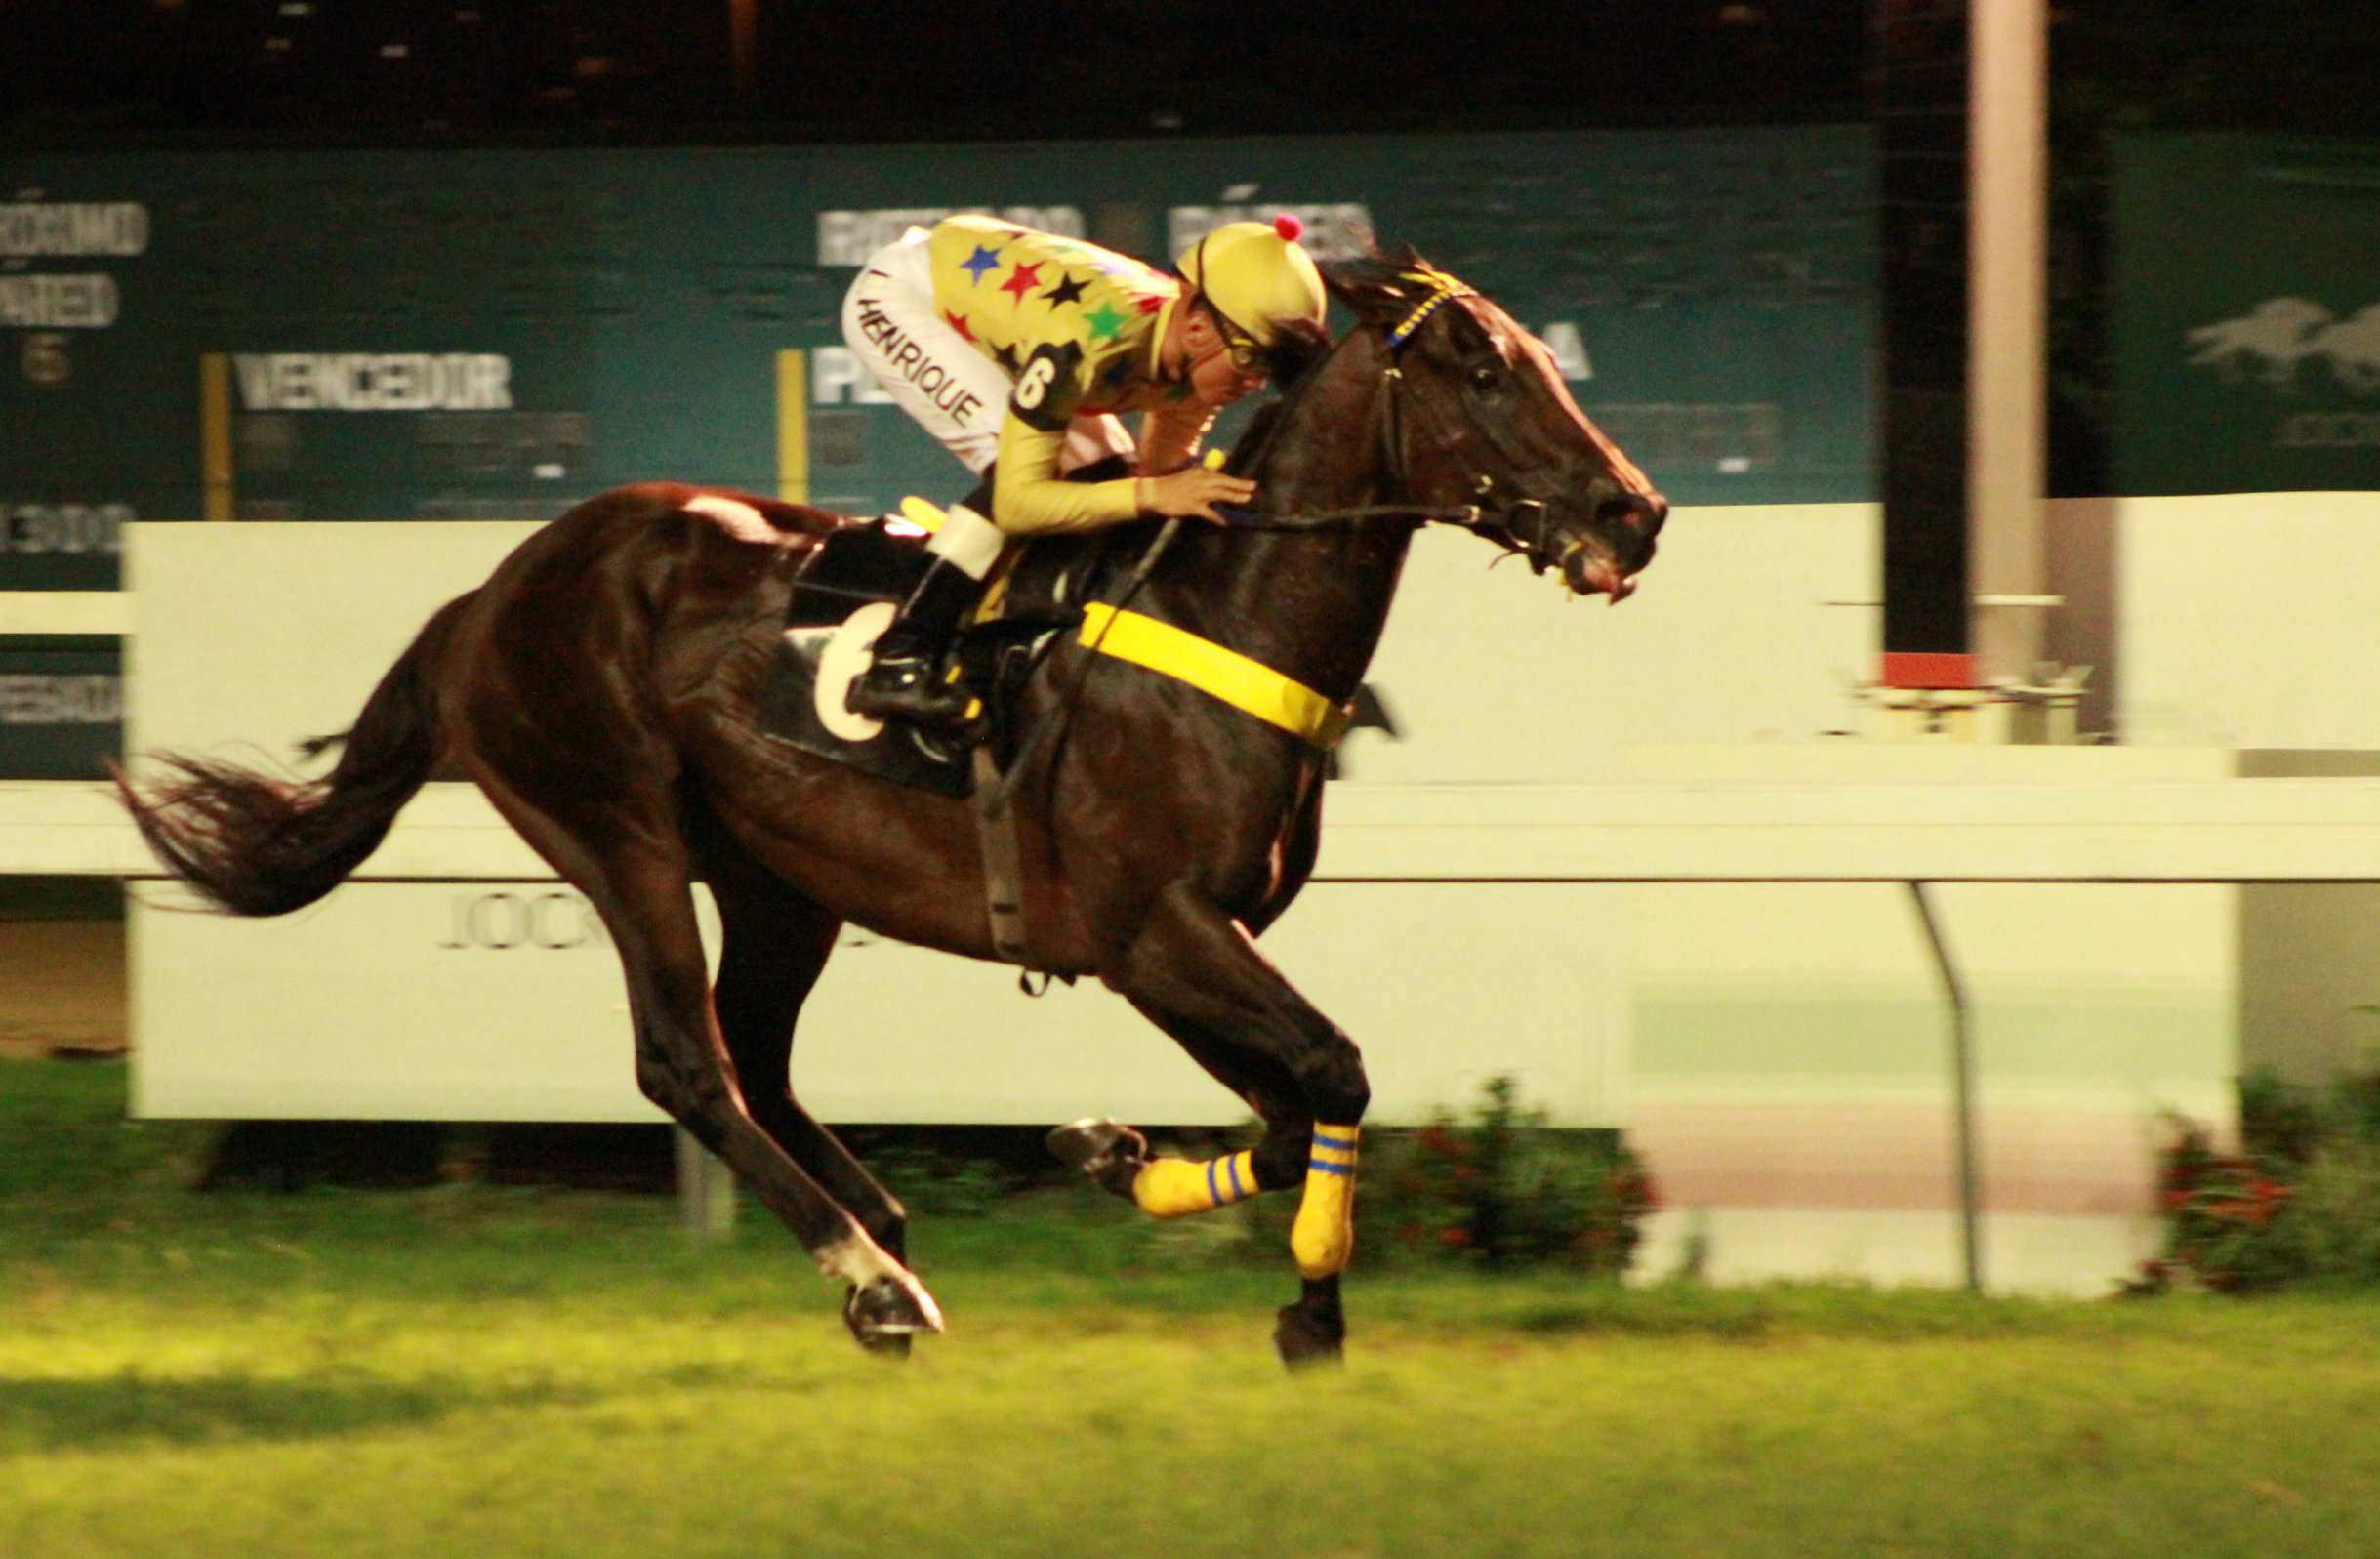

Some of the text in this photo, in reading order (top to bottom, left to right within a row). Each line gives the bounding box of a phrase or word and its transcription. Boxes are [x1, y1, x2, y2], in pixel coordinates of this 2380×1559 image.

[234, 352, 513, 411] VENCEDOR
[857, 299, 983, 429] HENRIQUE
[1016, 356, 1055, 410] 6
